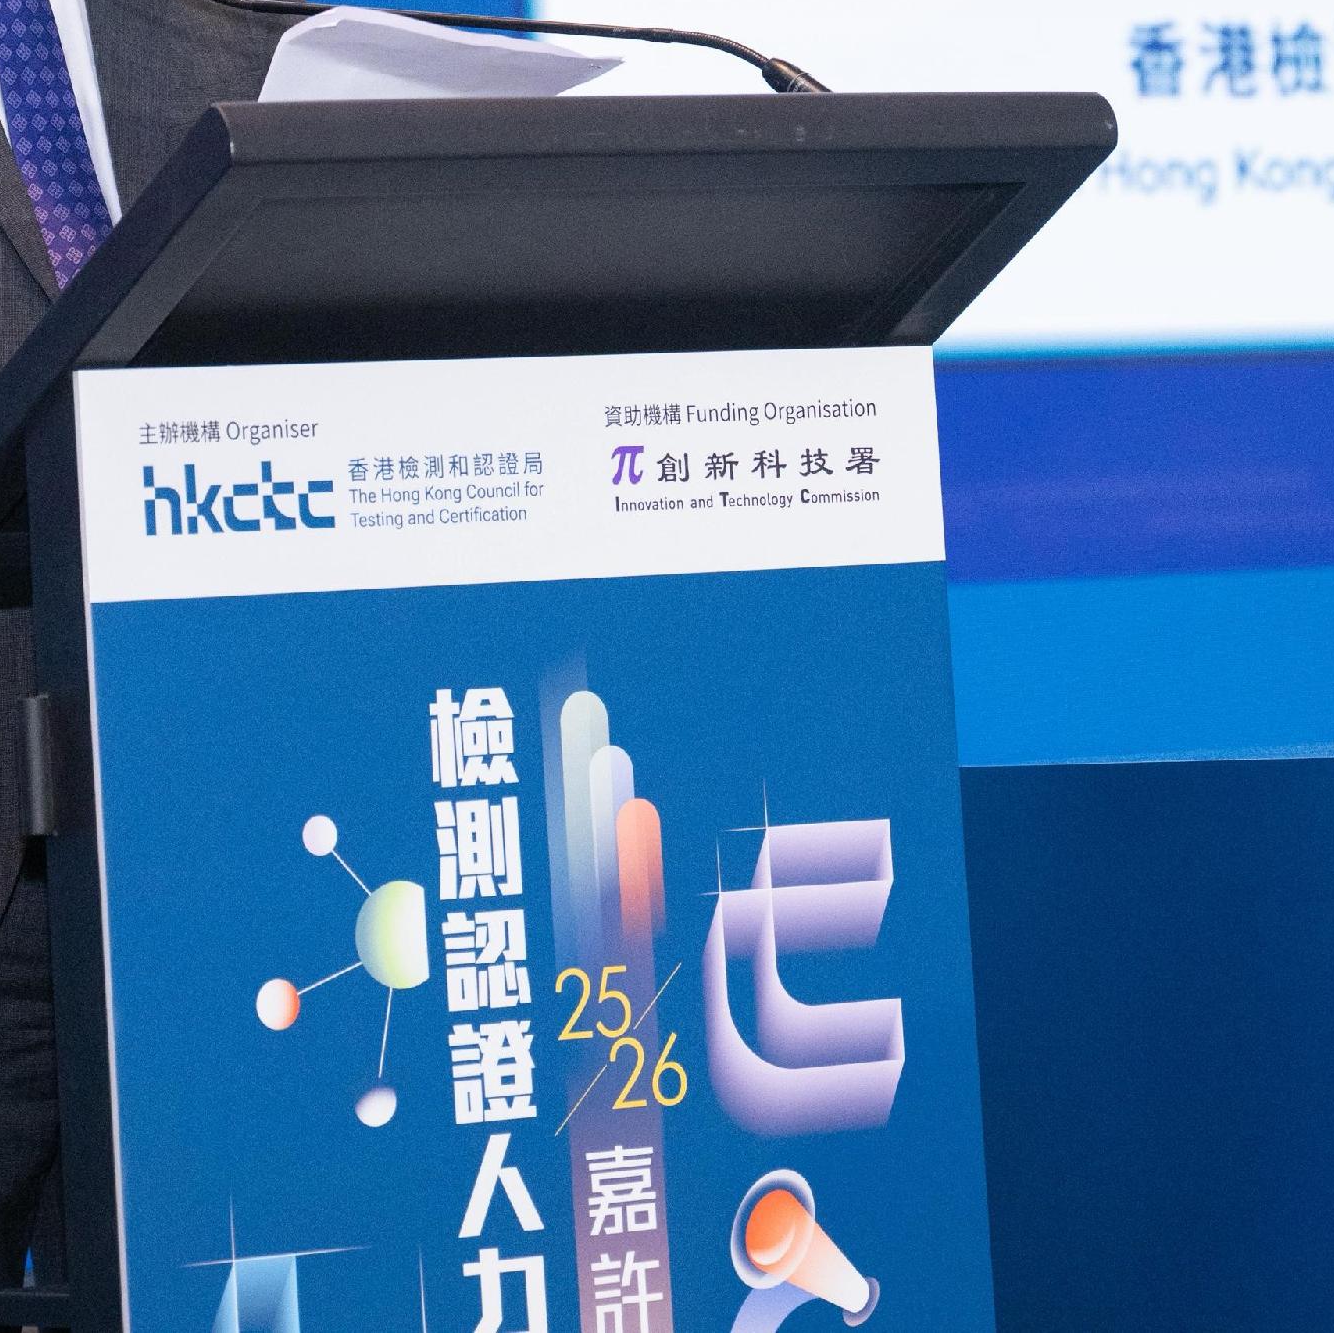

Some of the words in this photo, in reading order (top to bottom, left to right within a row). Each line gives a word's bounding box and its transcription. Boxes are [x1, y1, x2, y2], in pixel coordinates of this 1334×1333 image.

[604, 402, 682, 428] 資助機構
[686, 402, 760, 427] Funding
[764, 400, 877, 425] Organisation
[139, 420, 221, 445] 主辦機構
[225, 420, 319, 446] Organiser
[347, 451, 543, 482] 香港檢測和認證局
[656, 446, 881, 482] 創新科技署
[143, 461, 335, 535] hkctc
[348, 488, 377, 504] The
[381, 487, 420, 506] Hong
[425, 485, 462, 504] Kong
[466, 481, 520, 500] Council
[523, 480, 544, 497] for
[614, 495, 684, 513] Innovation
[690, 495, 714, 509] and
[718, 491, 794, 509] Technology
[800, 488, 880, 504] Commission
[350, 512, 404, 530] Testing
[407, 509, 435, 526] and
[439, 505, 527, 525] Certification
